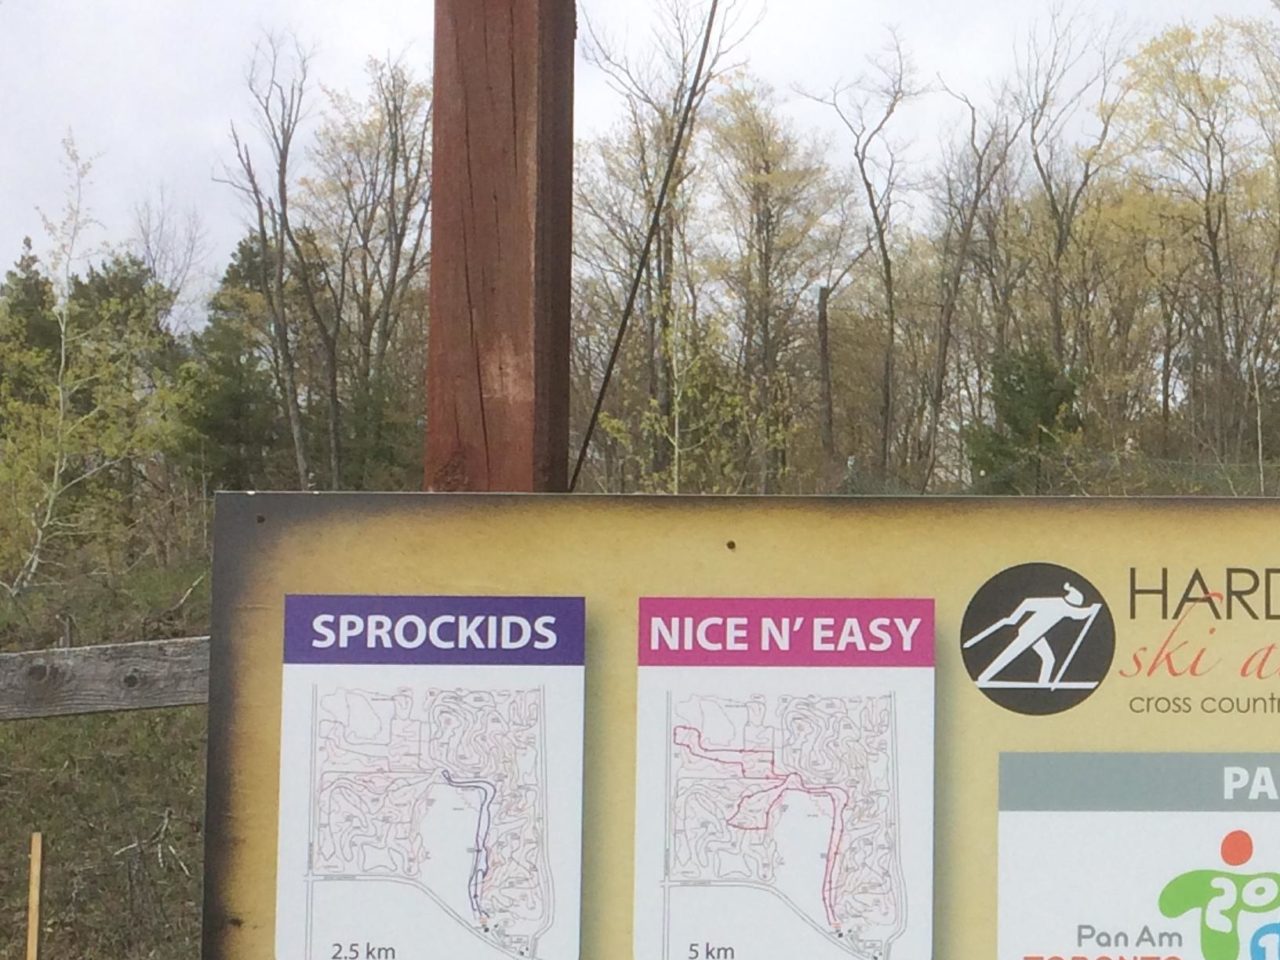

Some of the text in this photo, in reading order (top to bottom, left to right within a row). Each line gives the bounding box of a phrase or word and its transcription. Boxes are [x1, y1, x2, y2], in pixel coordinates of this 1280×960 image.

[311, 614, 558, 650] SPROCKIDS
[649, 616, 748, 651] NICE
[812, 617, 922, 653] EASY
[1119, 589, 1224, 681] ski
[1129, 693, 1195, 715] cross
[1077, 924, 1183, 947] Pan Am
[331, 942, 397, 960] 2.5 km
[688, 942, 735, 960] 5 km
